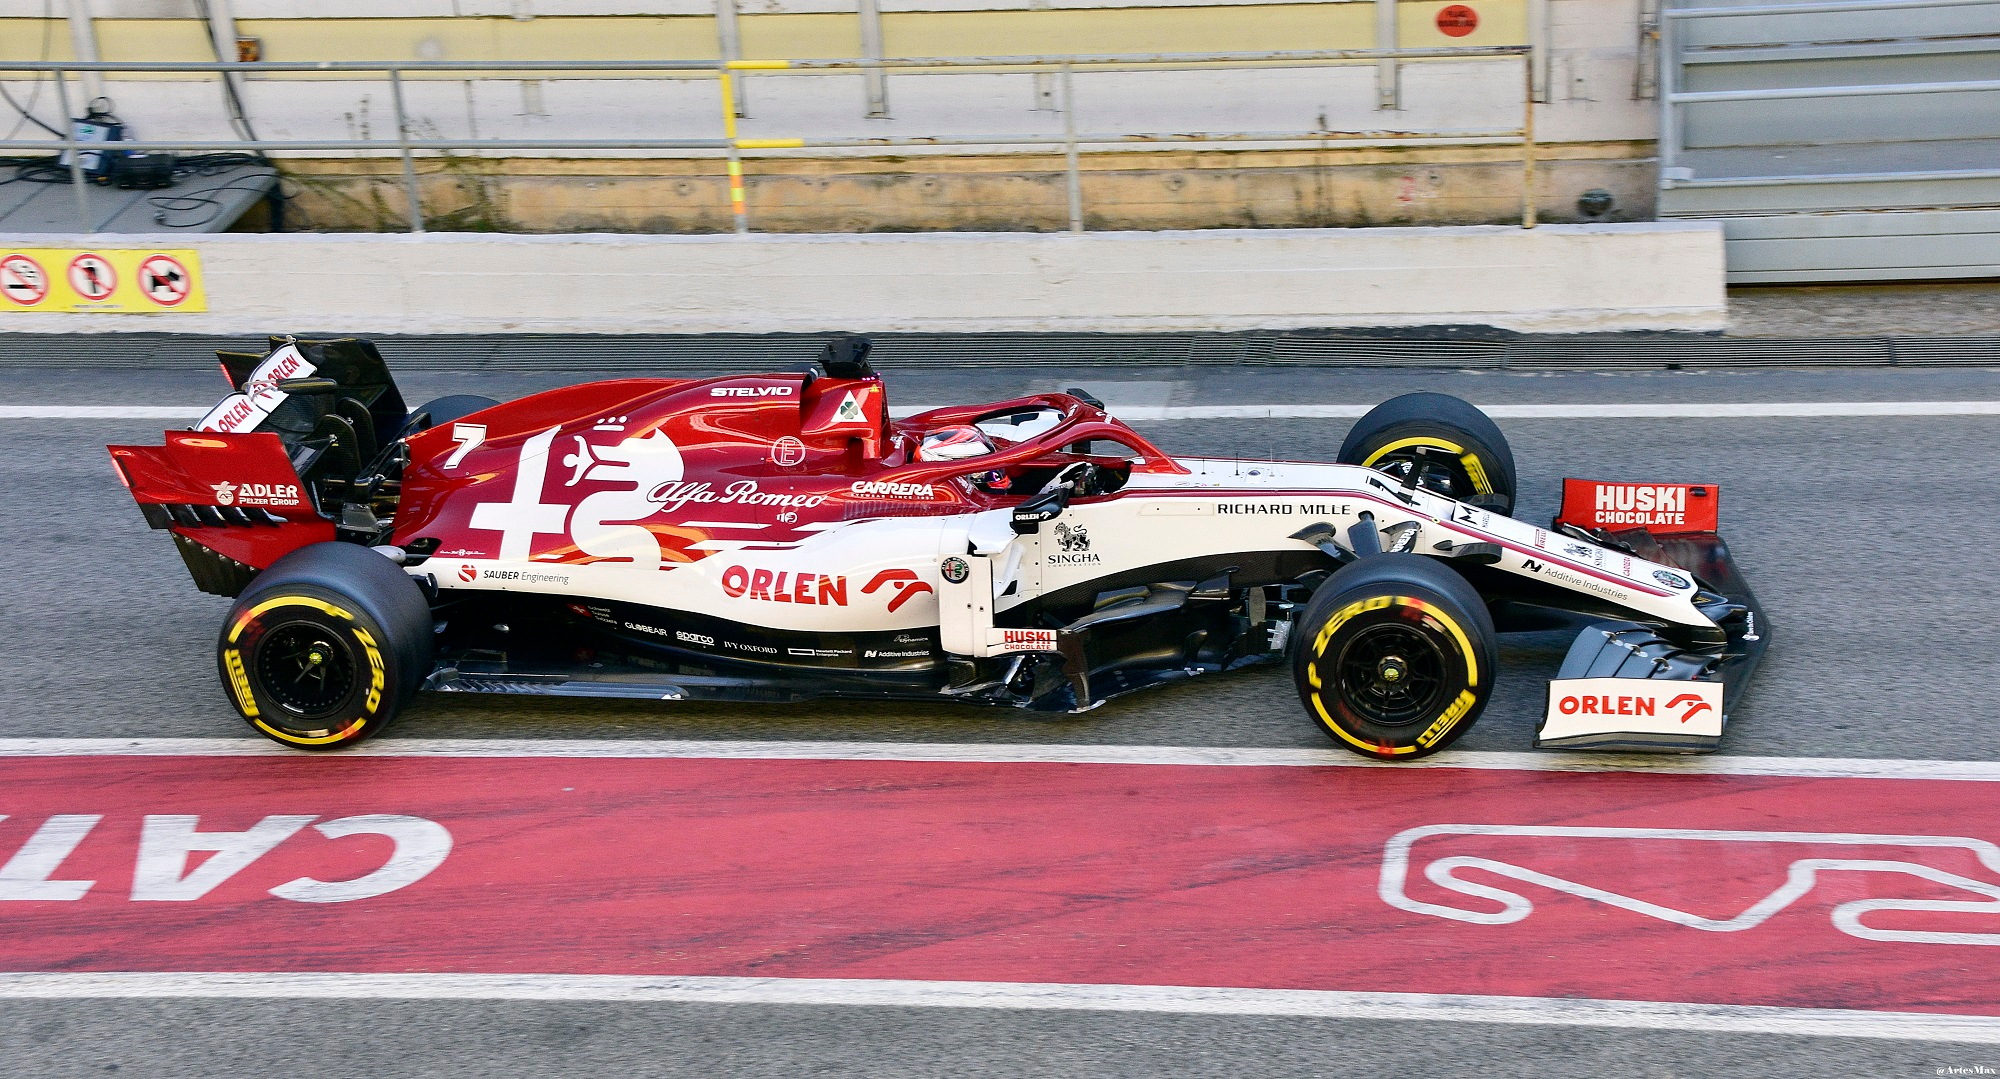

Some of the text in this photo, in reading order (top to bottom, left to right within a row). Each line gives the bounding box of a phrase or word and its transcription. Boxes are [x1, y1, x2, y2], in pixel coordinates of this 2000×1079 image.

[710, 386, 793, 397] STELVIO
[218, 399, 253, 433] ORLEN
[443, 423, 487, 469] 7
[238, 483, 299, 498] ADLER
[851, 480, 934, 497] CARRERA
[239, 497, 300, 506] PELZER GROUP
[646, 480, 828, 513] Alfa Romeo
[1595, 485, 1686, 512] HUSKI
[1217, 503, 1351, 515] RICHARD MILLE
[1015, 513, 1039, 521] ORLEN
[1595, 511, 1685, 525] CHOCOLATE
[1047, 553, 1100, 565] SINGHA
[483, 570, 570, 585] SAUBER Engineering
[1544, 567, 1628, 601] Additive Industries
[722, 564, 848, 607] ORLEN
[624, 621, 668, 636] GLOBEAIR
[1004, 630, 1051, 644] HUSKI
[724, 641, 778, 654] IVY OXFORD
[878, 649, 930, 658] Additive Industries
[352, 627, 385, 714] ZERO
[1559, 695, 1655, 716] ORLEN
[1416, 688, 1476, 749] PIRELLI
